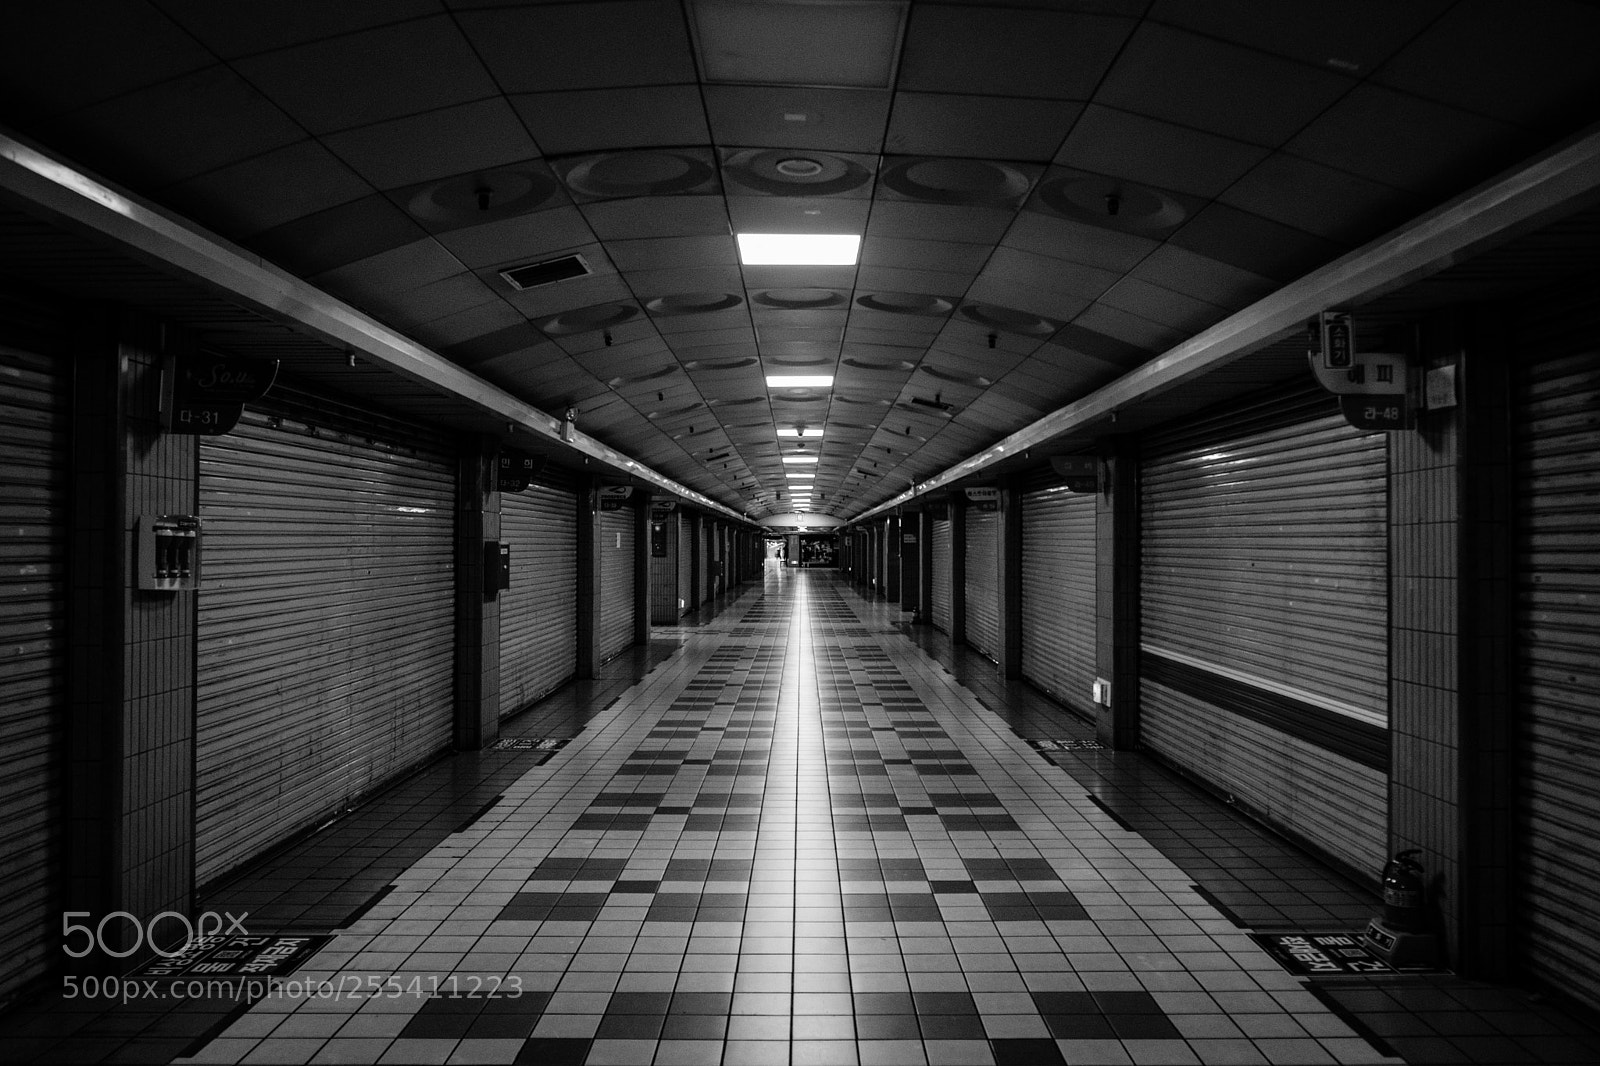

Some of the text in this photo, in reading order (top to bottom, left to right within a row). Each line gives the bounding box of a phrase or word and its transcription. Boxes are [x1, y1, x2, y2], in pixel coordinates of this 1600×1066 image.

[1333, 327, 1346, 361] 소화기
[180, 409, 219, 424] 다-31
[1364, 407, 1399, 420] 라-48
[238, 937, 310, 973] 적재금지
[1279, 936, 1343, 972] 적재금지
